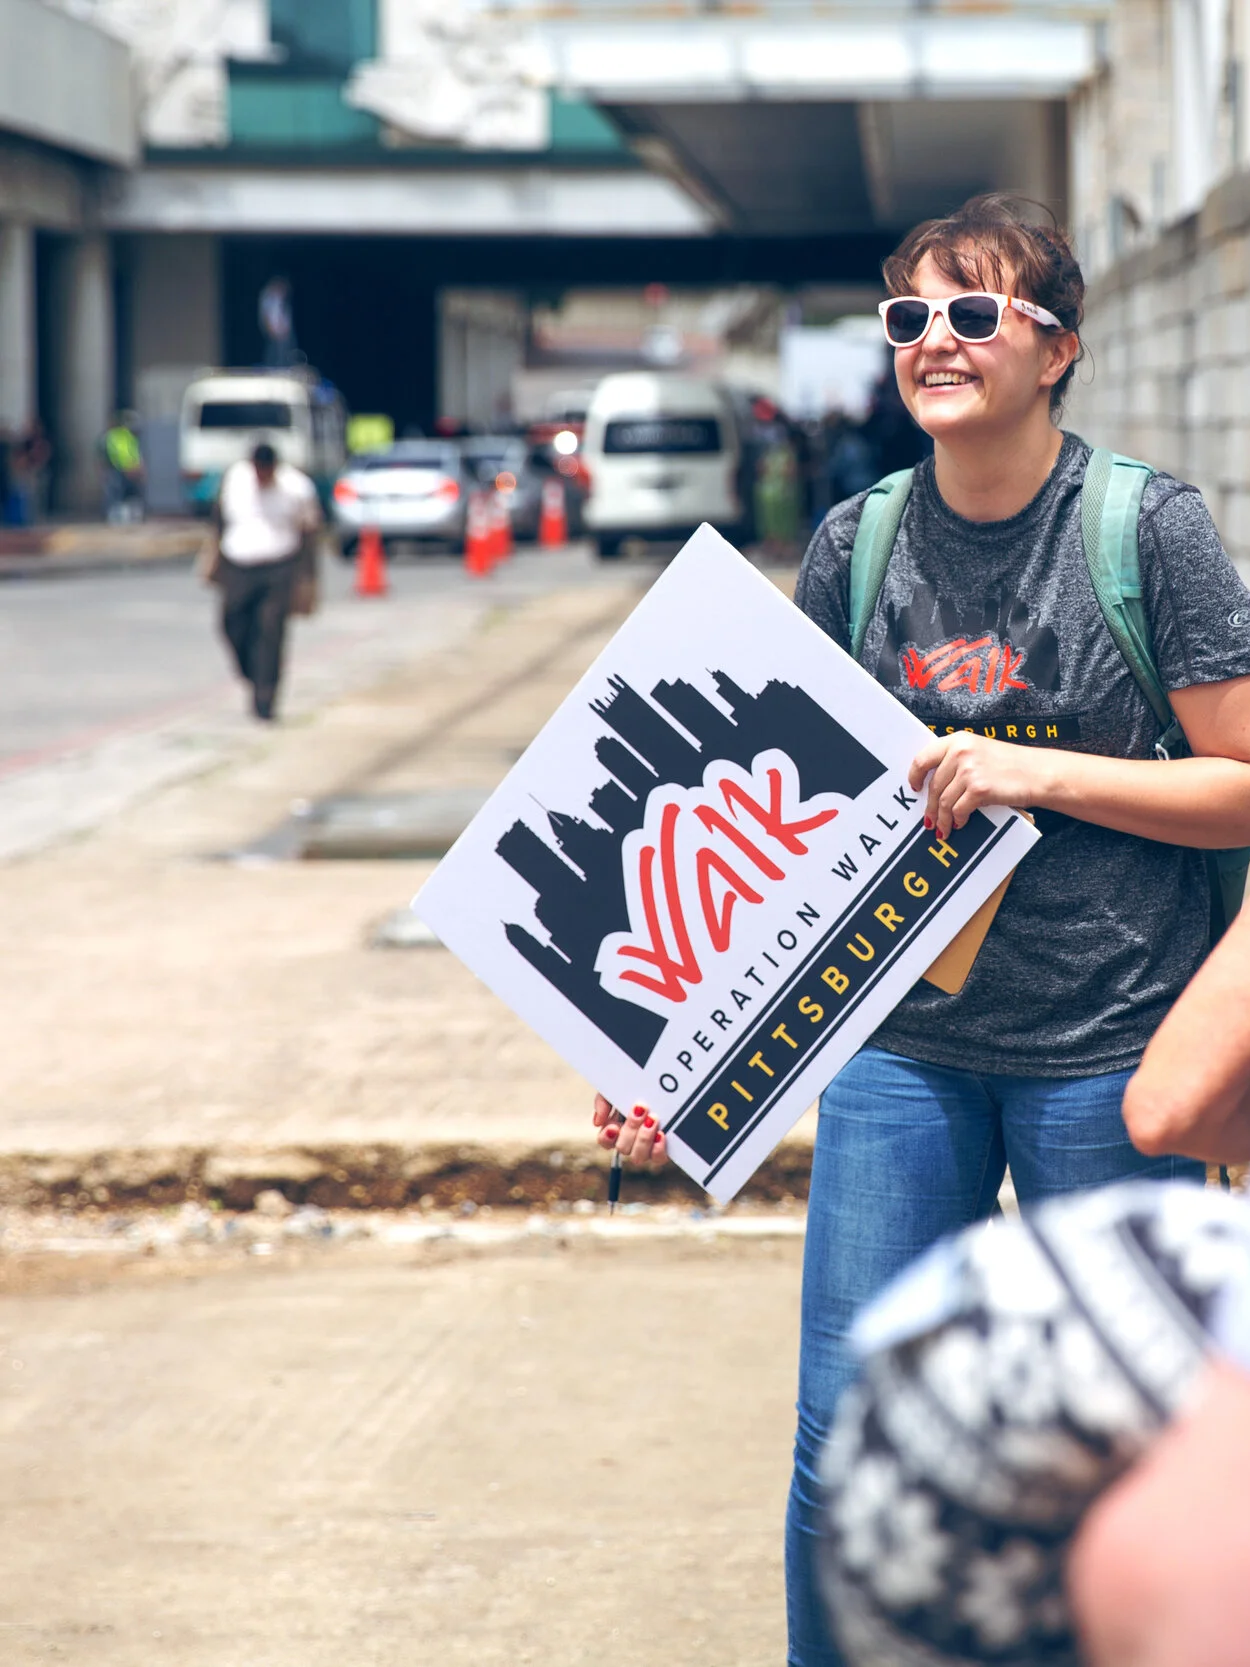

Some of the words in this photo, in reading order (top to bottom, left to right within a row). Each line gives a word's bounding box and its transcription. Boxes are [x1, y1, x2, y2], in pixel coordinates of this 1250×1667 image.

[659, 902, 821, 1094] OPERATION
[832, 785, 918, 882] WALK
[707, 838, 959, 1131] PITTSBURGH
